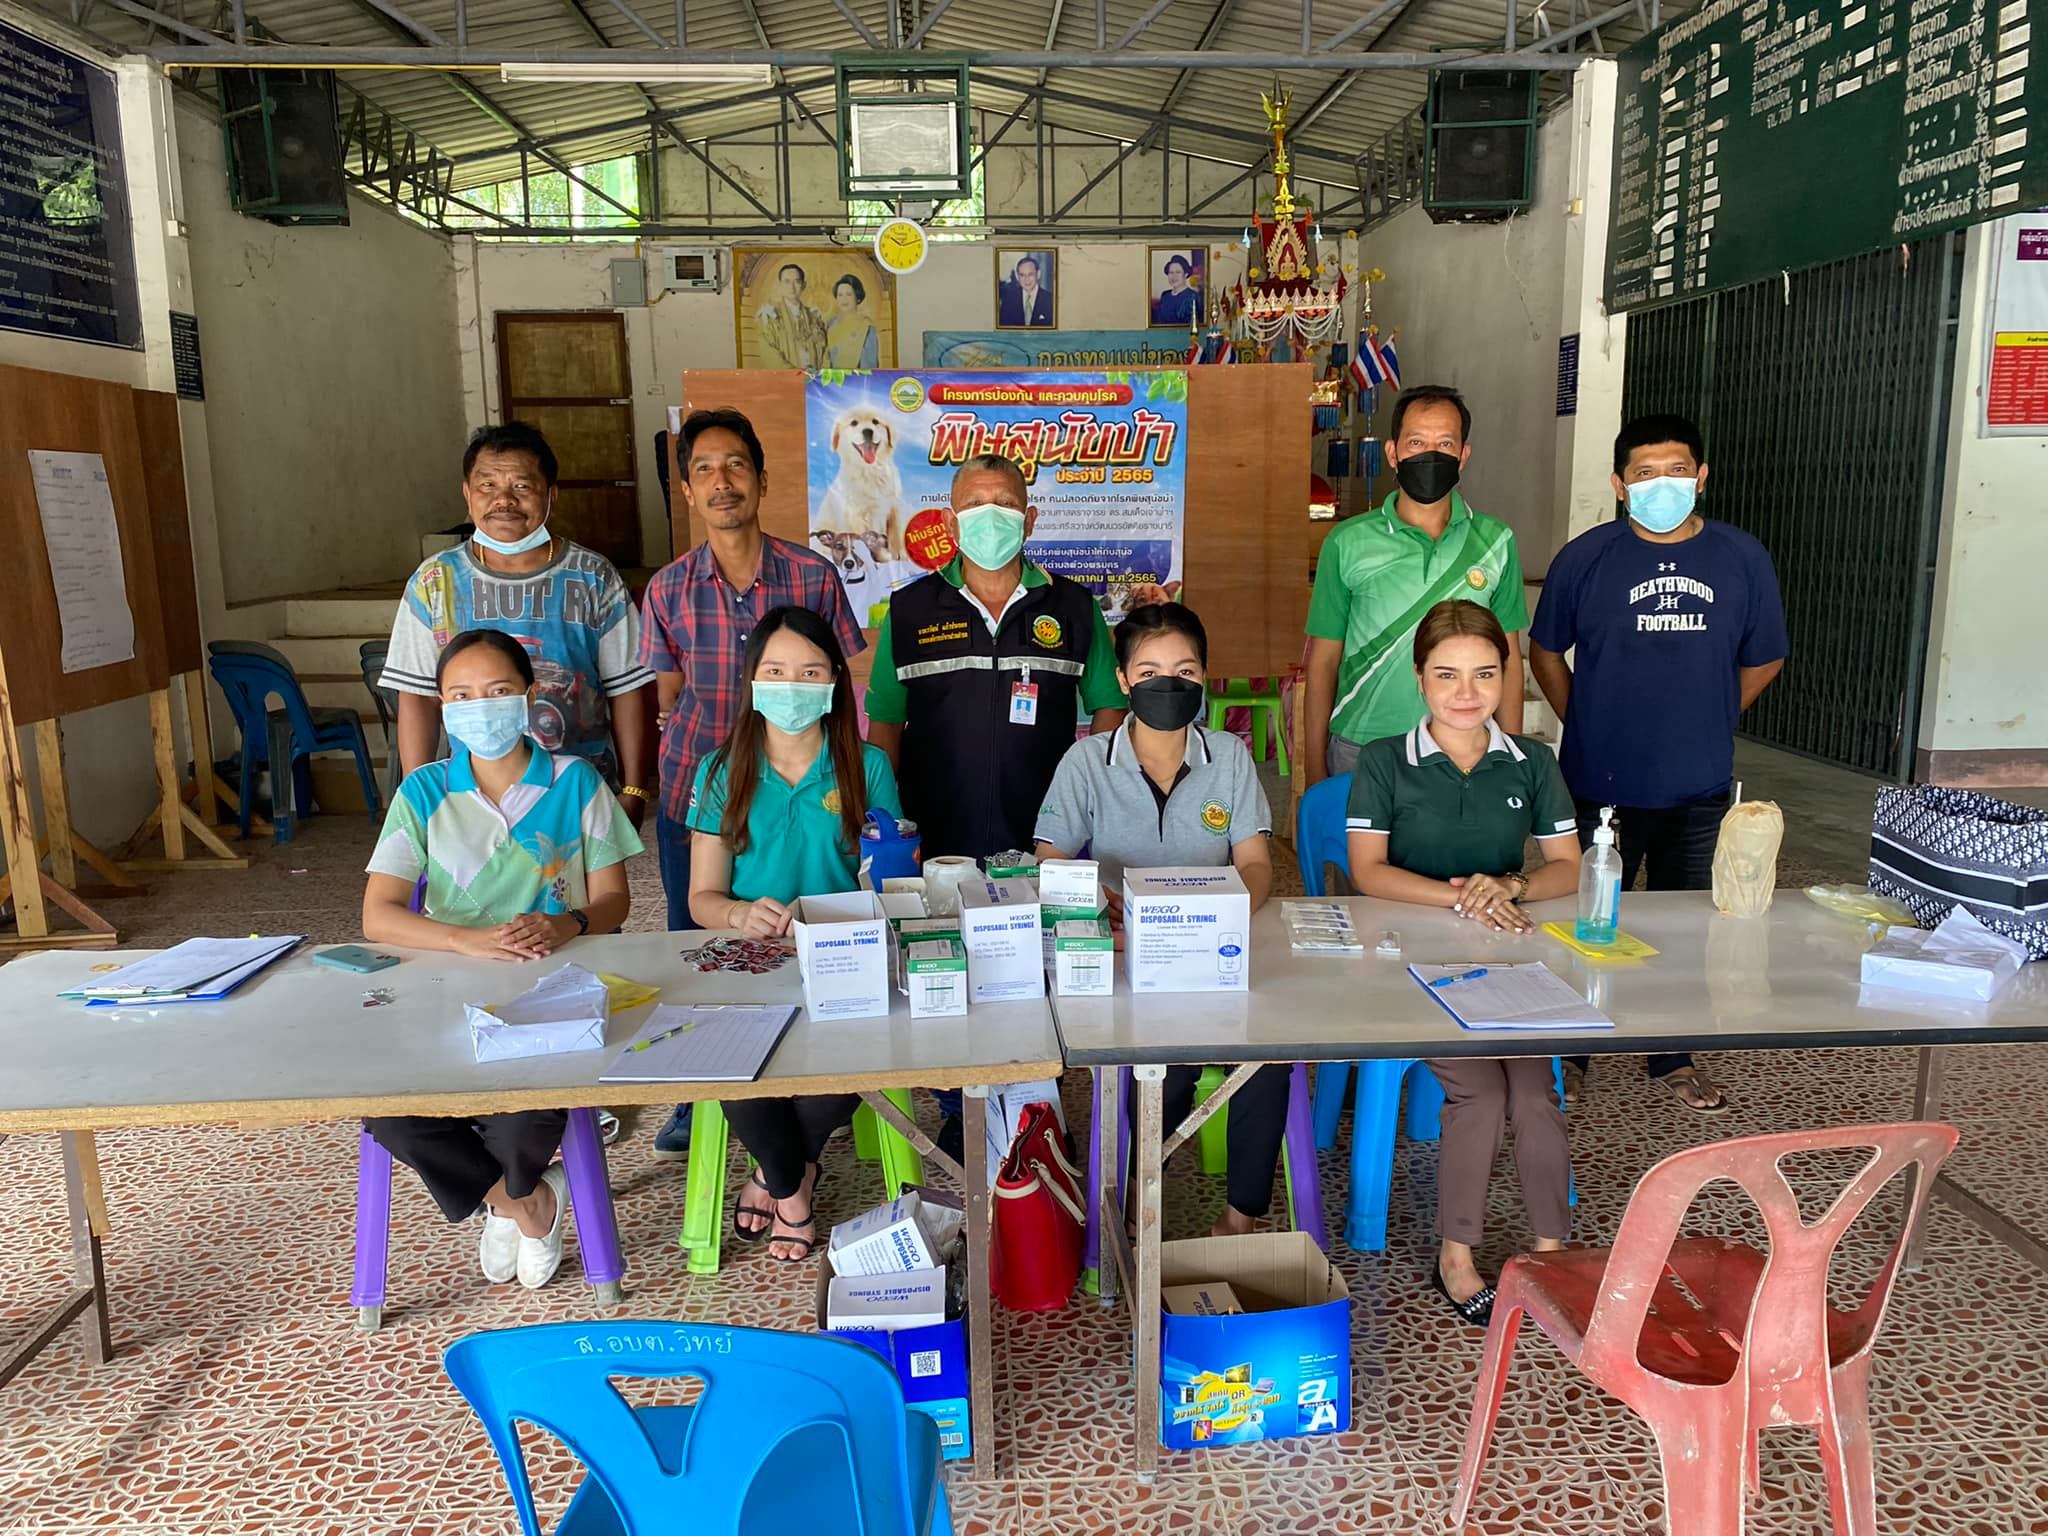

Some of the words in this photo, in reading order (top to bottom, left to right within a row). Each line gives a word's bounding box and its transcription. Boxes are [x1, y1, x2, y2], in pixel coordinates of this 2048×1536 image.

[1037, 341, 1189, 368] กองทนแม่ของ
[943, 386, 1032, 402] โครงการป้องกัน
[1039, 388, 1118, 405] และควบคุมโรค
[930, 408, 1176, 484] พิษสุนัขบ้า
[1055, 467, 1106, 483] ประจำปี
[1111, 468, 1154, 483] 2565
[906, 522, 946, 544] ให้บริกา
[924, 533, 952, 559] ฟรี
[472, 576, 554, 622] HOT
[1629, 576, 1714, 605] HEATHWOOD
[1636, 613, 1707, 632] FOOTBALL
[1140, 904, 1180, 914] WEGO
[973, 923, 1008, 933] DISPOSABLE
[1010, 921, 1035, 930] SYRINGE
[1140, 914, 1184, 924] DISPOSABLE
[1187, 914, 1217, 923] SYRINGE
[815, 939, 851, 948] DISPOSABLE
[853, 937, 879, 946] SYRINGE
[853, 929, 879, 937] WEGO
[891, 1230, 914, 1272] DISPOSABLE
[900, 1227, 921, 1263] WEGO
[884, 1285, 931, 1295] DISPOSABLE
